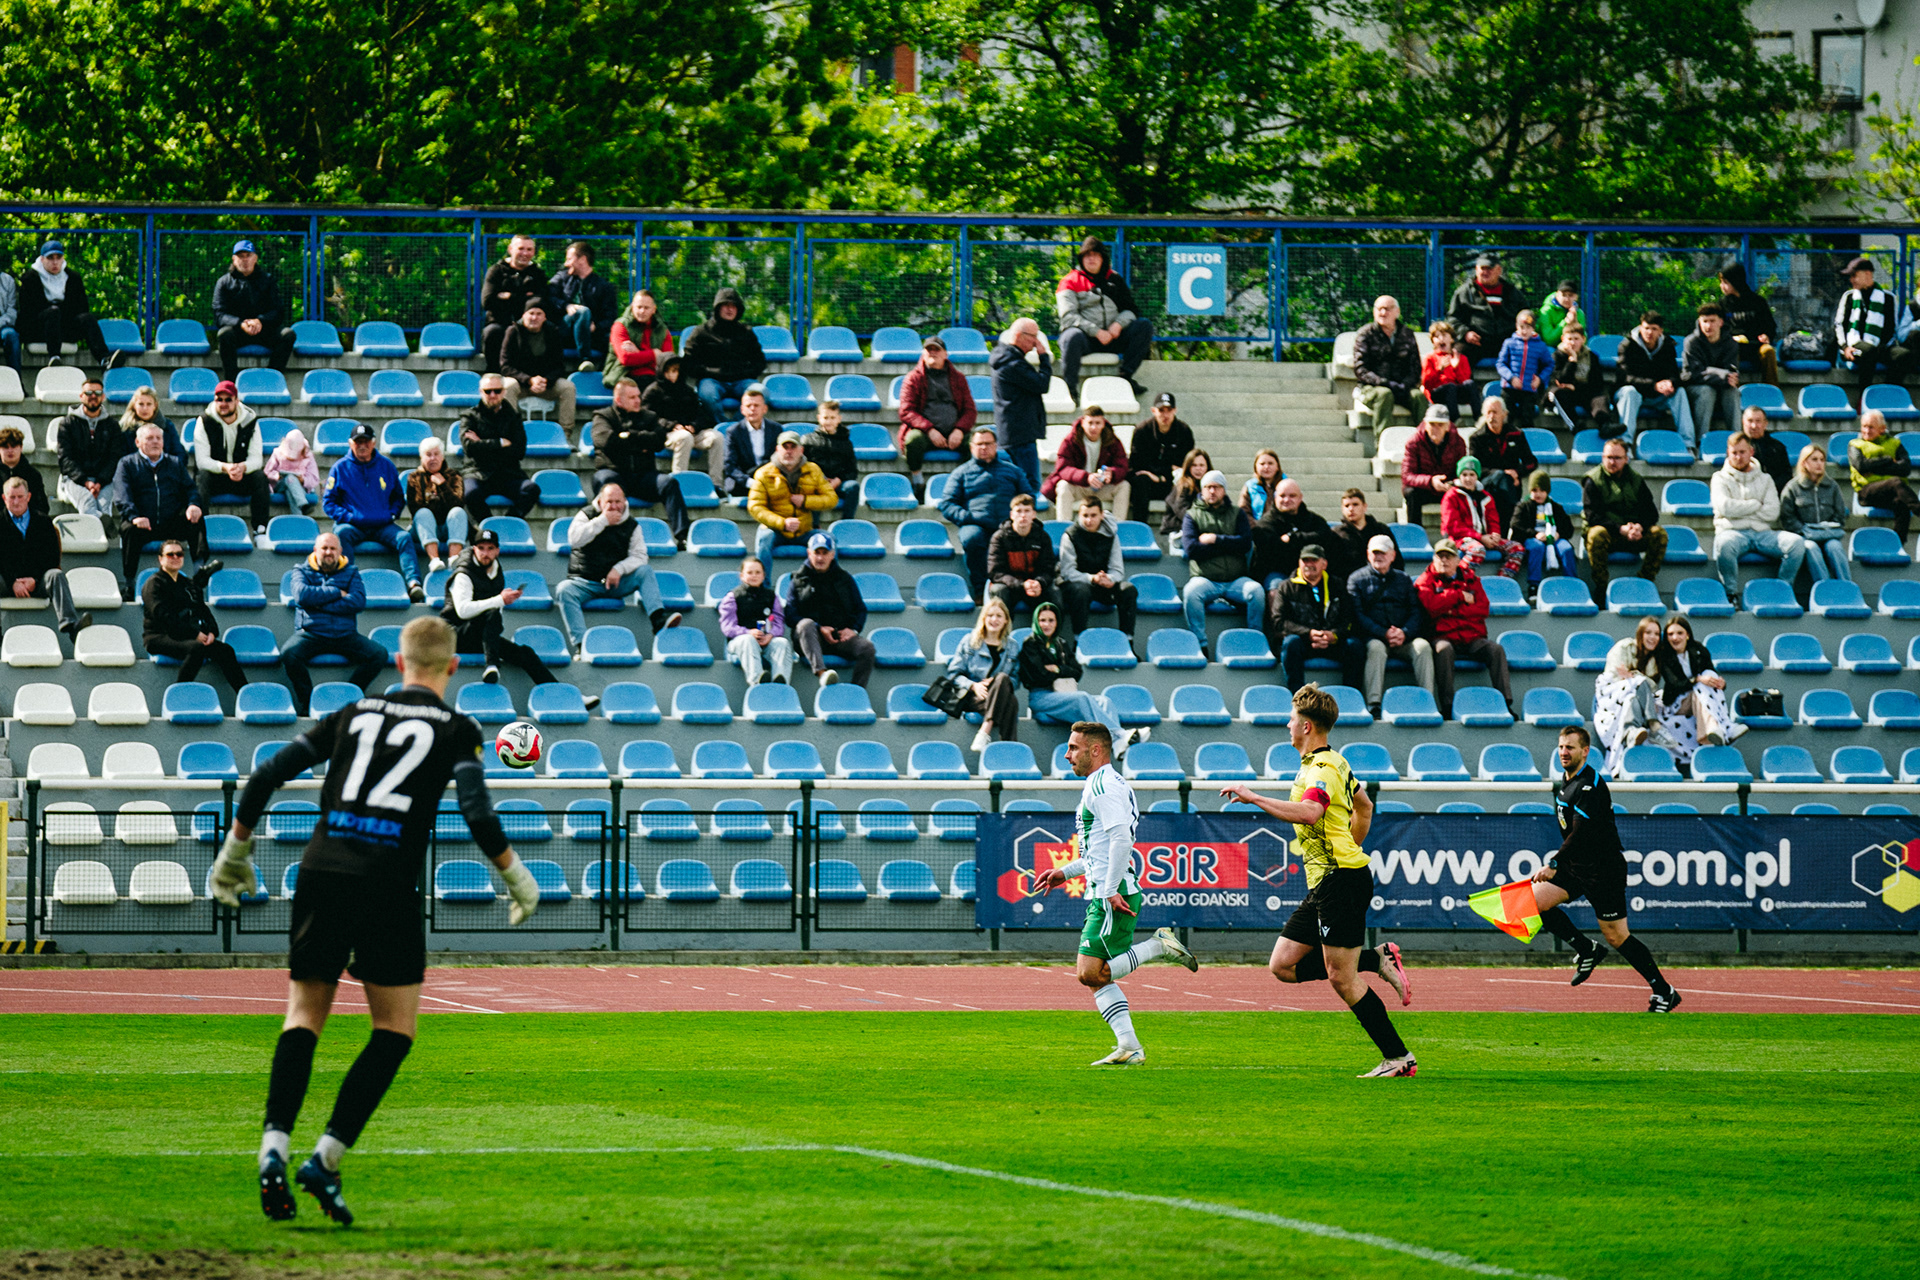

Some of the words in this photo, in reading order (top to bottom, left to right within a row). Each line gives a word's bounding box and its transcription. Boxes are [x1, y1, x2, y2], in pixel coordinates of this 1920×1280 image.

[1172, 252, 1222, 265] SEKTOR
[1179, 266, 1213, 311] C
[341, 712, 435, 813] 12
[1188, 891, 1249, 907] GDAŃSKI
